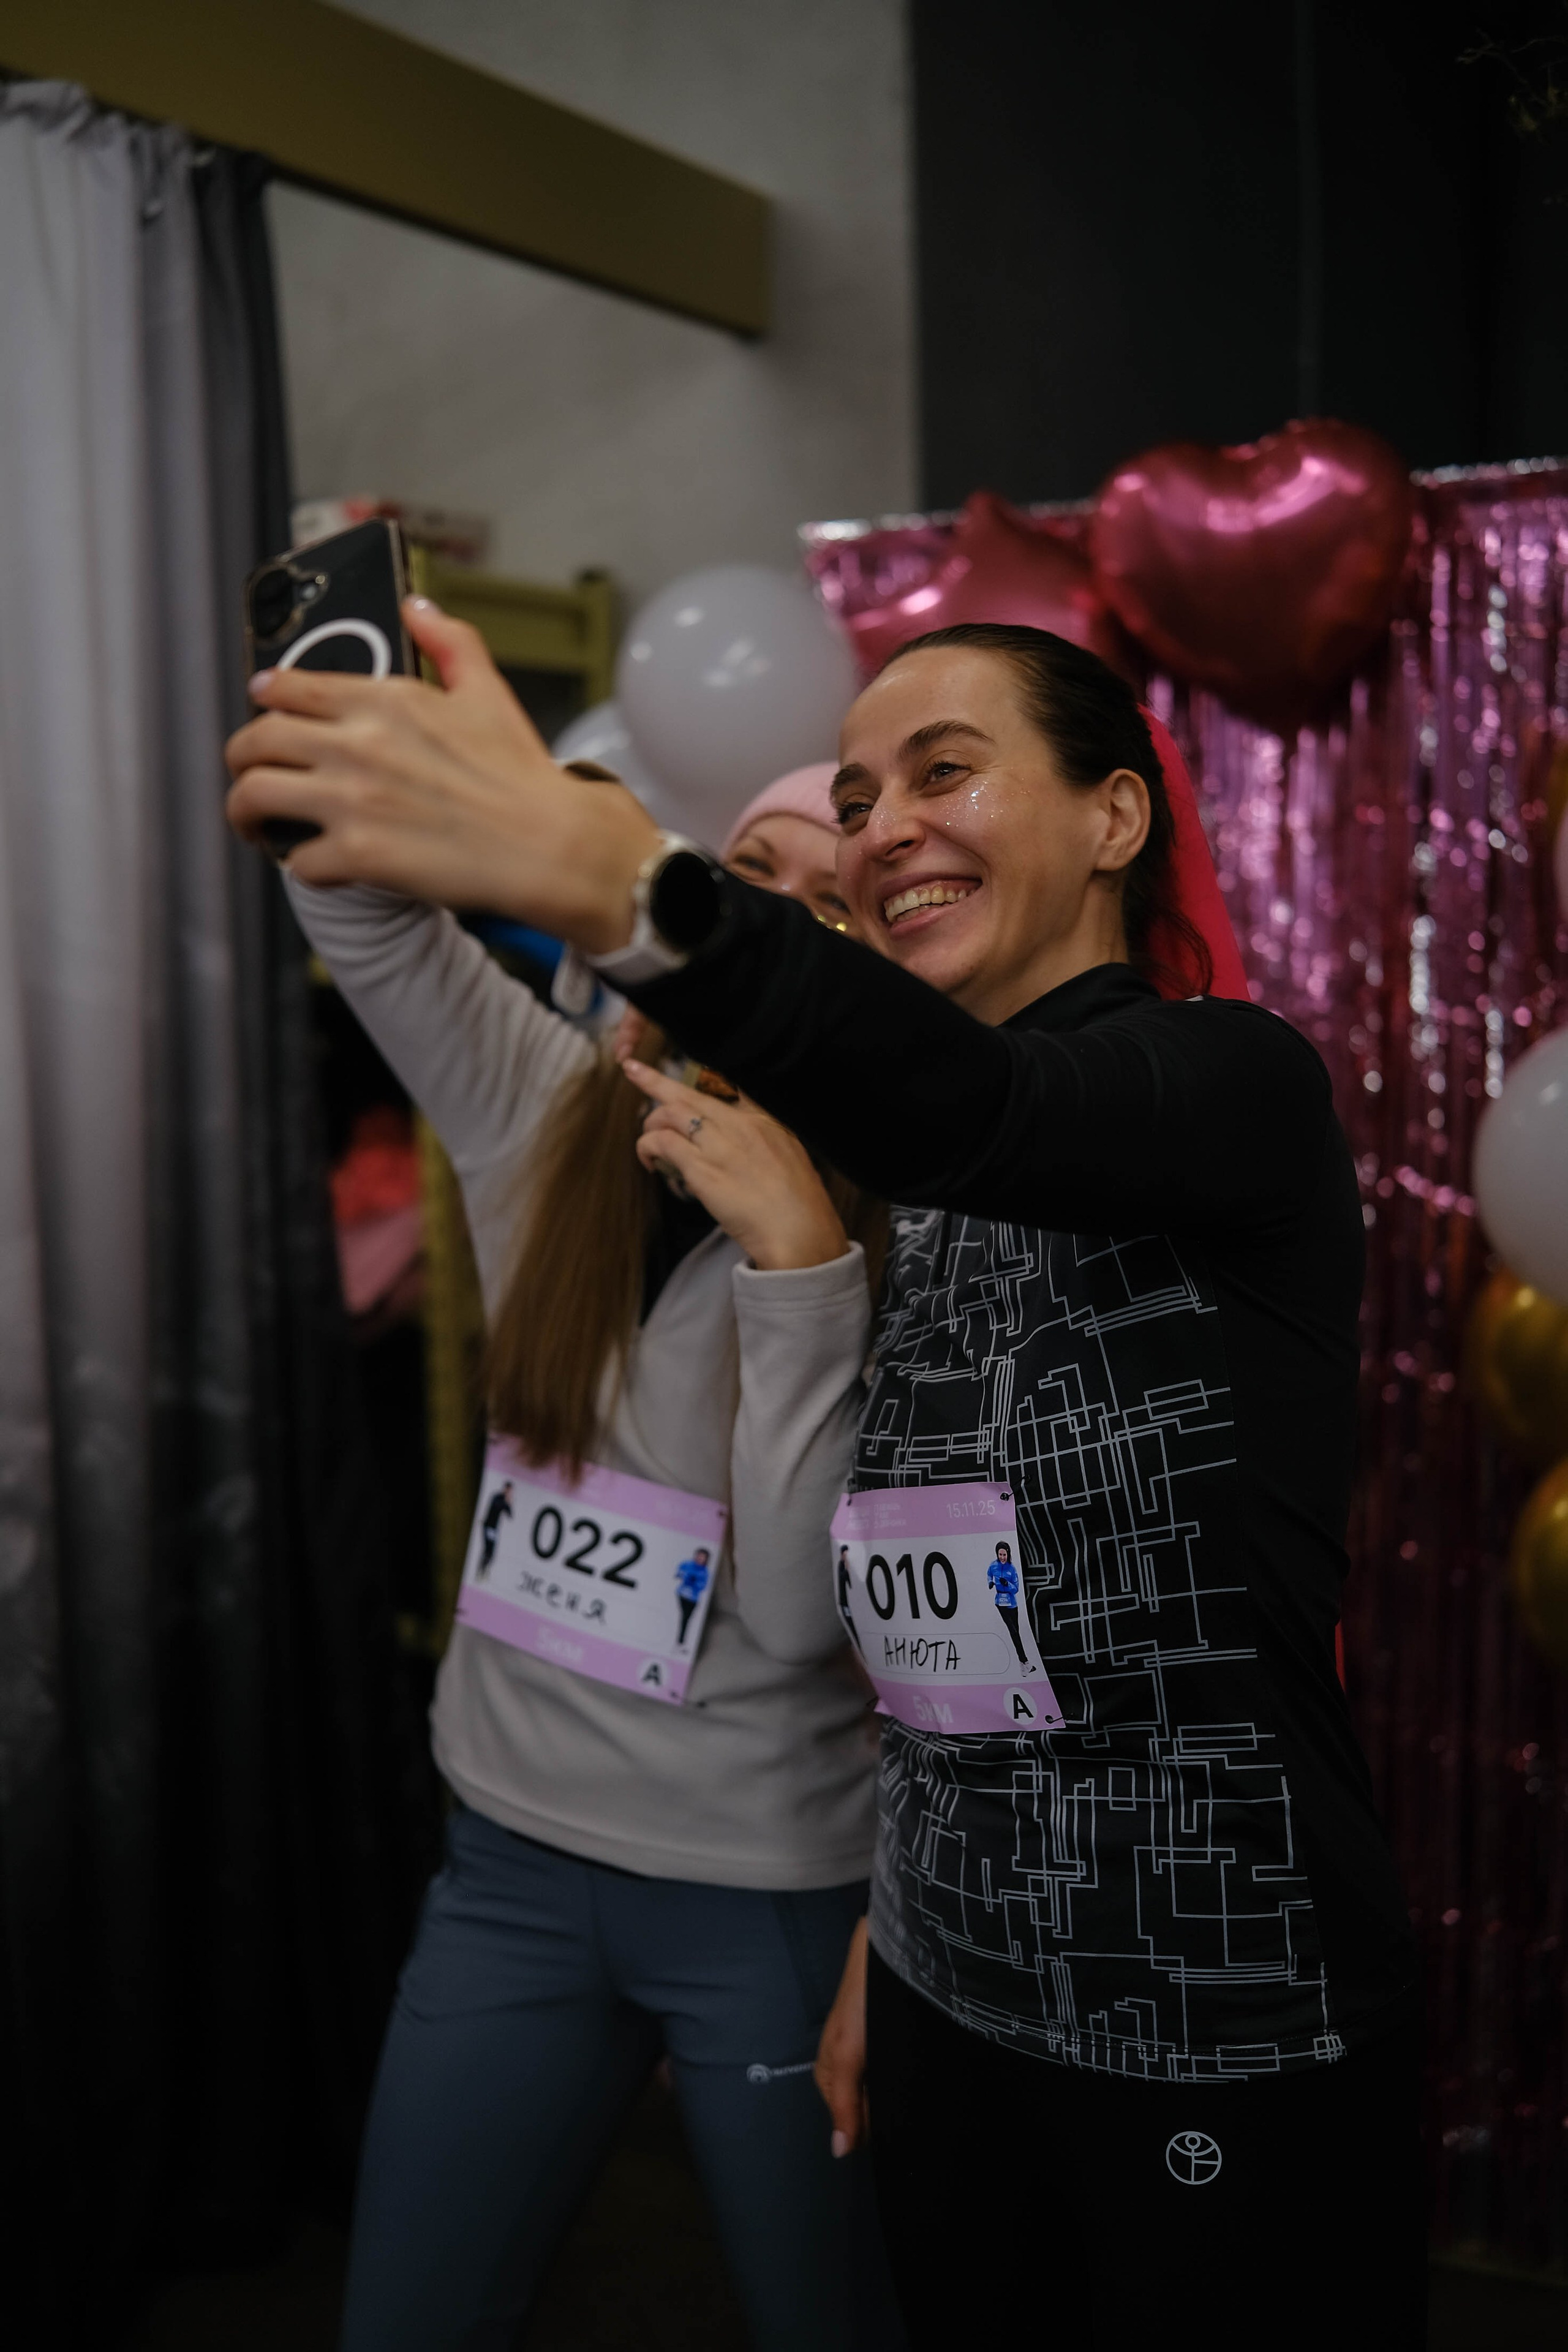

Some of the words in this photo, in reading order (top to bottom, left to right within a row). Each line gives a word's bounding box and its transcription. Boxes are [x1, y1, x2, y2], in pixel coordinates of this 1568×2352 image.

[946, 1499, 995, 1518] 15.11.25
[532, 1506, 644, 1588] 022
[865, 1551, 958, 1620] 010
[884, 1635, 961, 1672] АНЮТА
